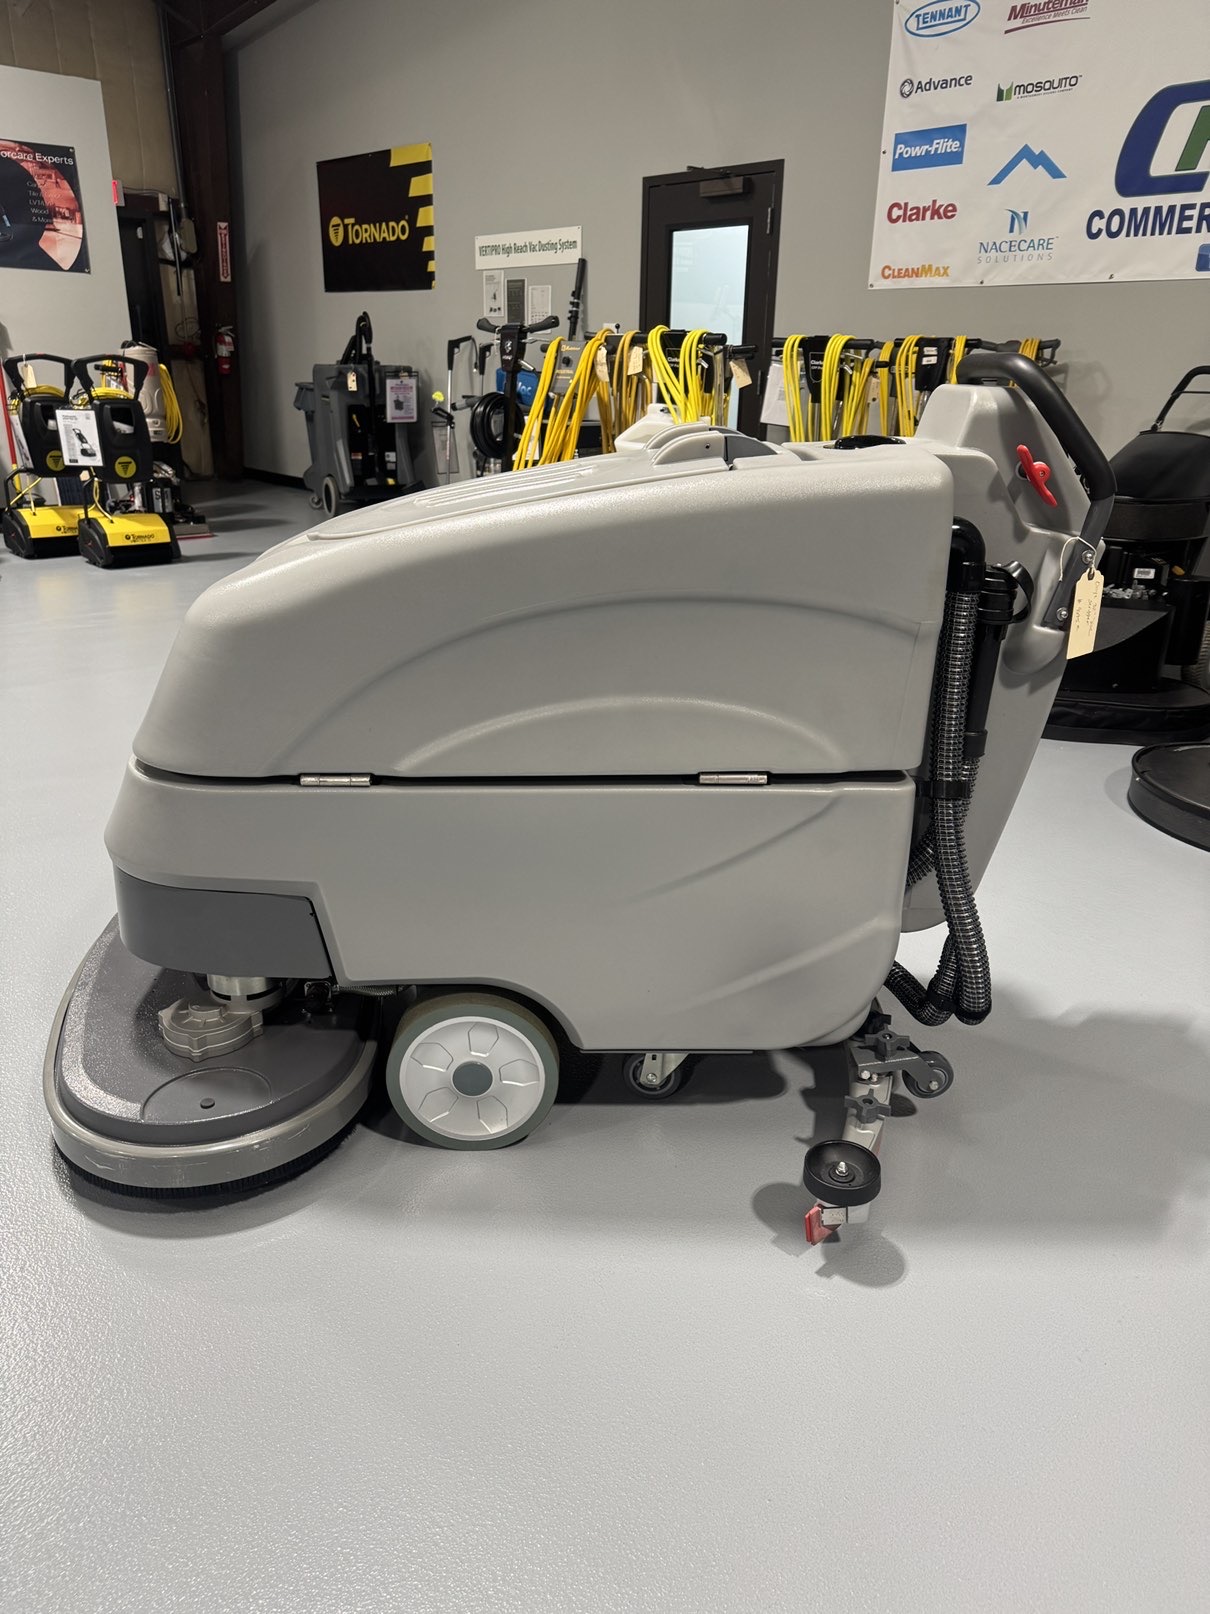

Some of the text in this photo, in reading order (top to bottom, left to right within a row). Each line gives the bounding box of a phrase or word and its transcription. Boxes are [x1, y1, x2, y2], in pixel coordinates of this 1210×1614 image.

[914, 4, 971, 29] TENNANT
[1022, 6, 1088, 24] Excellence Meets Clean
[914, 74, 973, 94] Advance
[894, 138, 960, 159] Powr-Flite
[35, 152, 74, 166] Experts
[887, 199, 957, 224] Clarke
[344, 217, 410, 245] TORNADO
[478, 238, 578, 258] VERTIPRO High Reach Vac Dusting System
[978, 237, 1055, 254] NACECARE
[977, 252, 1053, 265] SOLUTIONS
